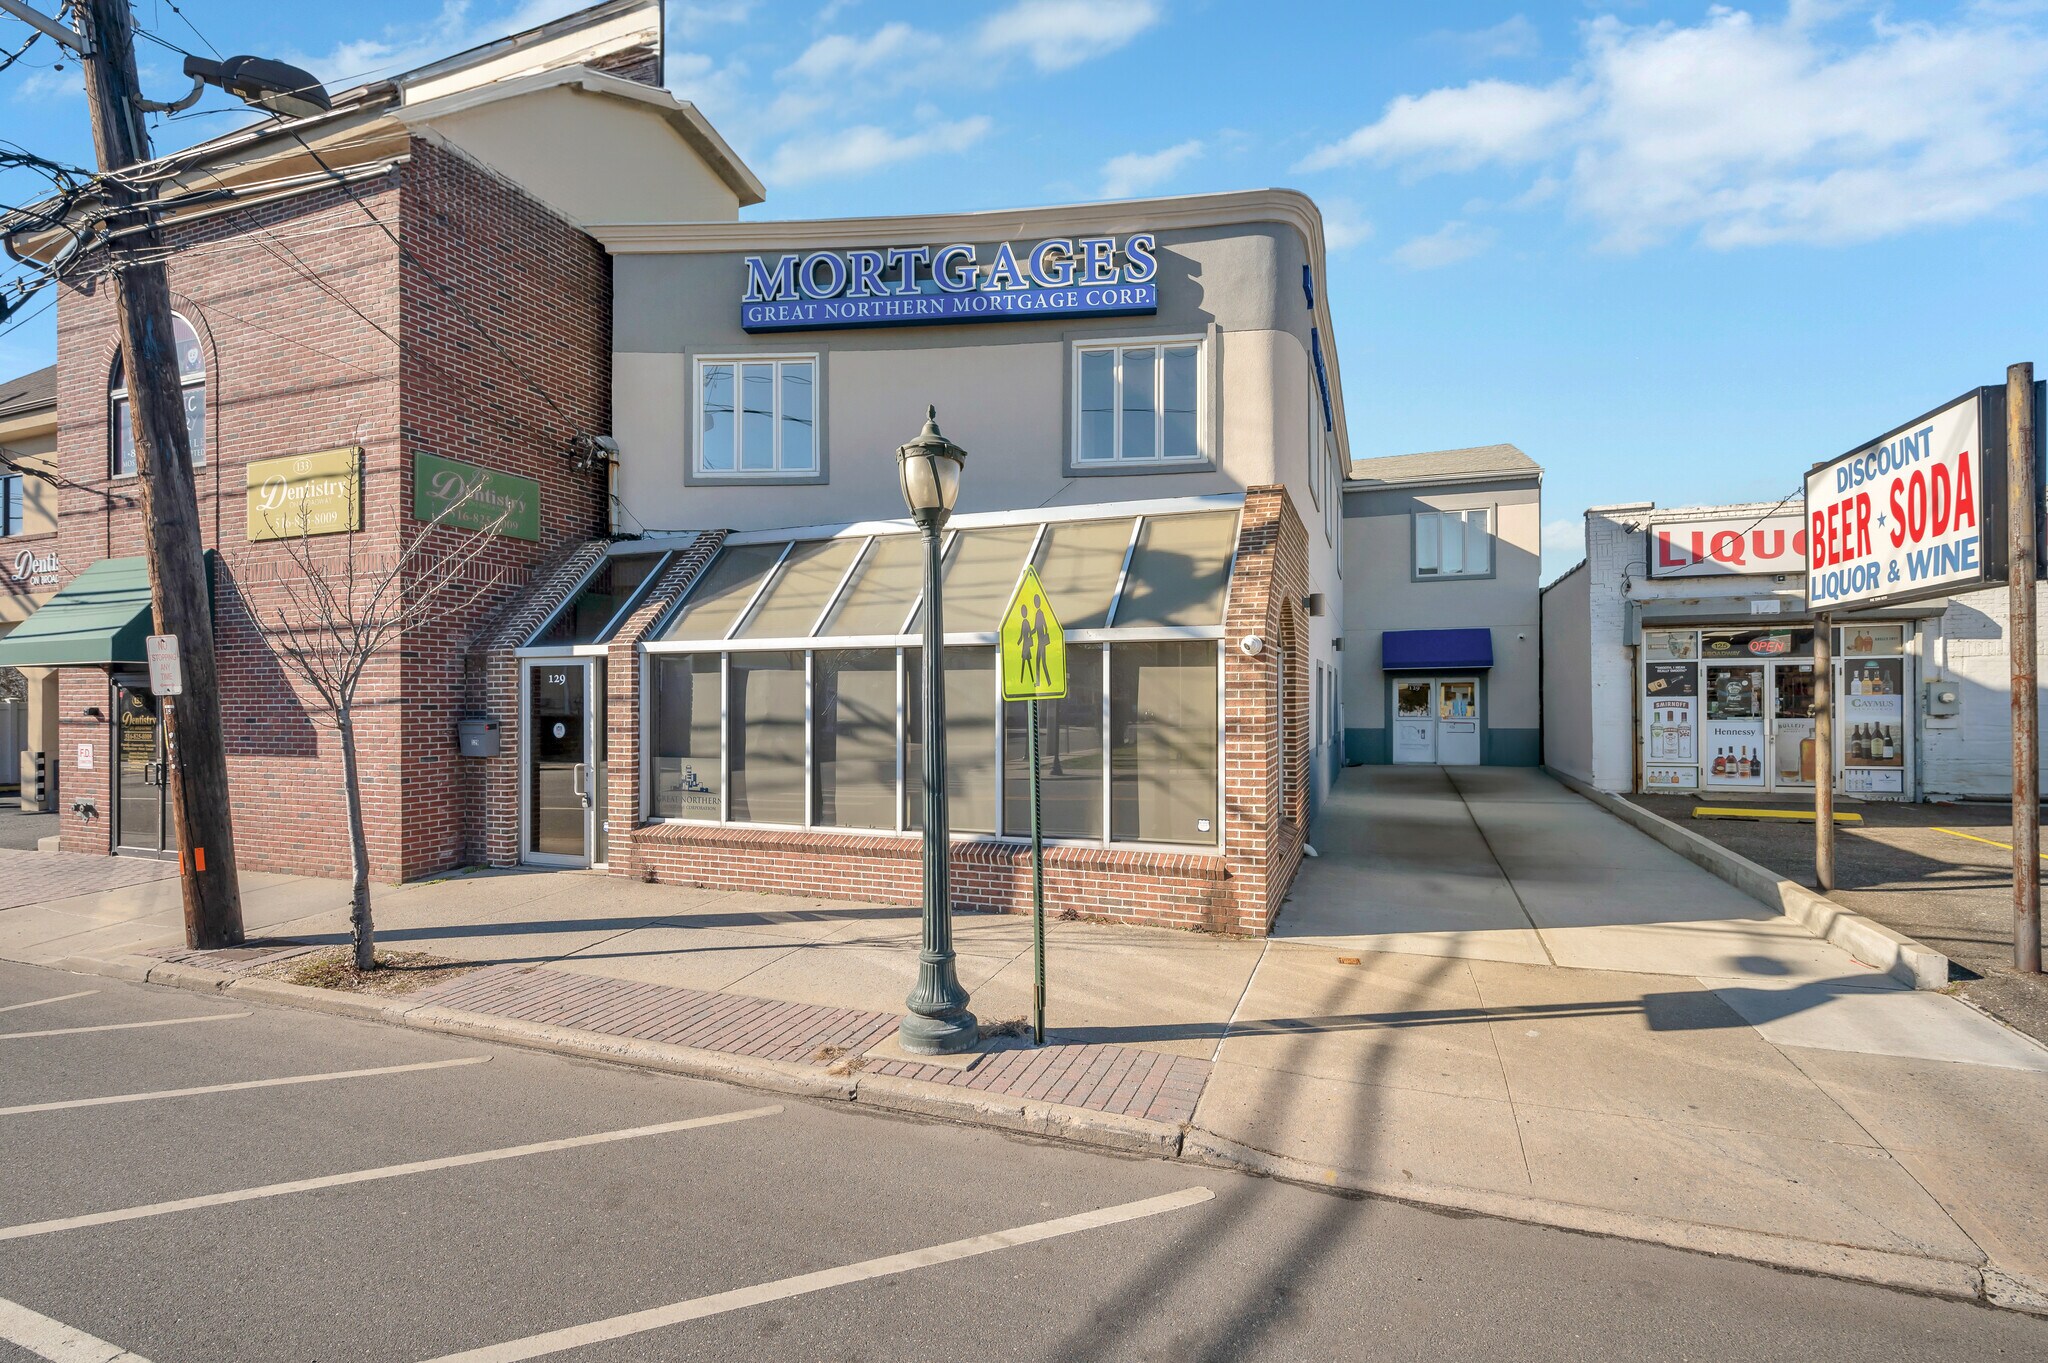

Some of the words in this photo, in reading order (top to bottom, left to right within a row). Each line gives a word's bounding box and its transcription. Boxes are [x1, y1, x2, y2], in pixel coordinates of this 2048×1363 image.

[742, 233, 1158, 303] MORTGAGES
[748, 304, 818, 322] GREAT
[824, 298, 945, 319] NORTHERN
[953, 291, 1079, 313] MORTGAGE
[1086, 288, 1150, 306] CORP.
[1836, 425, 1934, 493] DISCOUNT
[296, 461, 309, 471] 133
[256, 474, 346, 511] Dentistry
[1812, 491, 1872, 570] BEER
[1890, 450, 1976, 549] SODA
[1811, 561, 1881, 601] LIQUOR
[1887, 559, 1900, 583] &
[1906, 536, 1979, 581] WINE
[158, 641, 168, 651] NO
[1749, 641, 1785, 652] OPEN
[152, 653, 177, 661] STOPPING
[160, 663, 171, 671] ANY
[160, 672, 173, 680] TIME
[548, 674, 566, 685] 129
[1851, 699, 1894, 708] CAYMUS
[121, 711, 158, 728] Dentistry
[1714, 728, 1757, 736] Hennessy
[681, 796, 722, 805] NORTHERN
